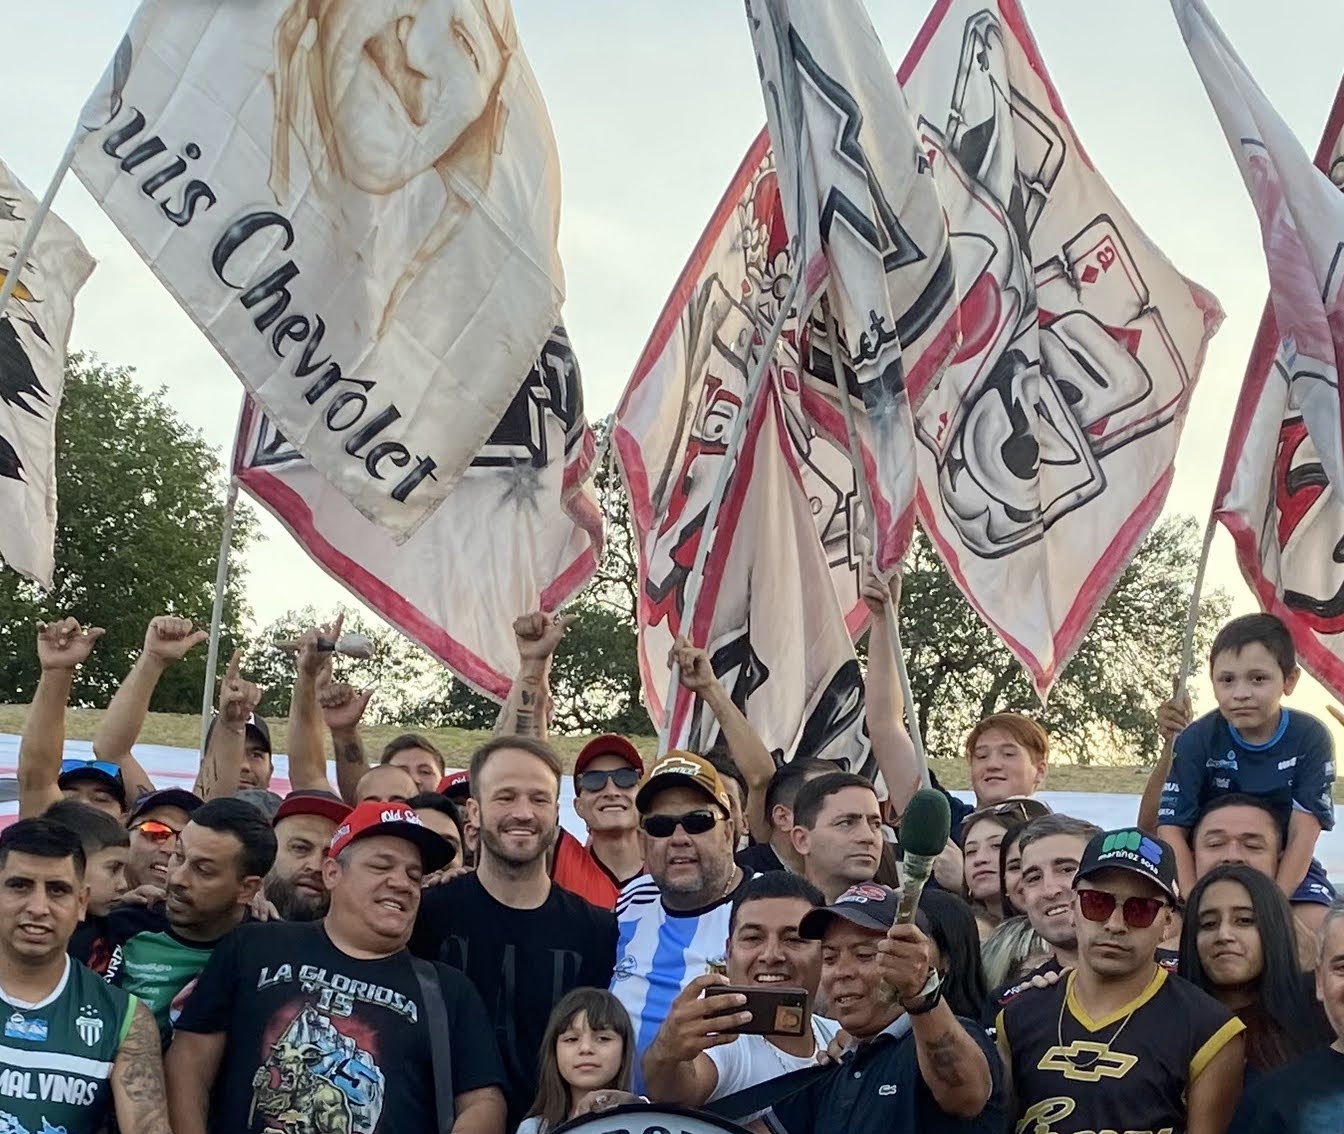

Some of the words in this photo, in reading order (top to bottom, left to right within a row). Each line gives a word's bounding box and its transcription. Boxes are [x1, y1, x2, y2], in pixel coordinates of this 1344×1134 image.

[211, 209, 439, 504] Chevrolet
[257, 963, 293, 992] LA
[299, 964, 419, 1025] GLORIOSA
